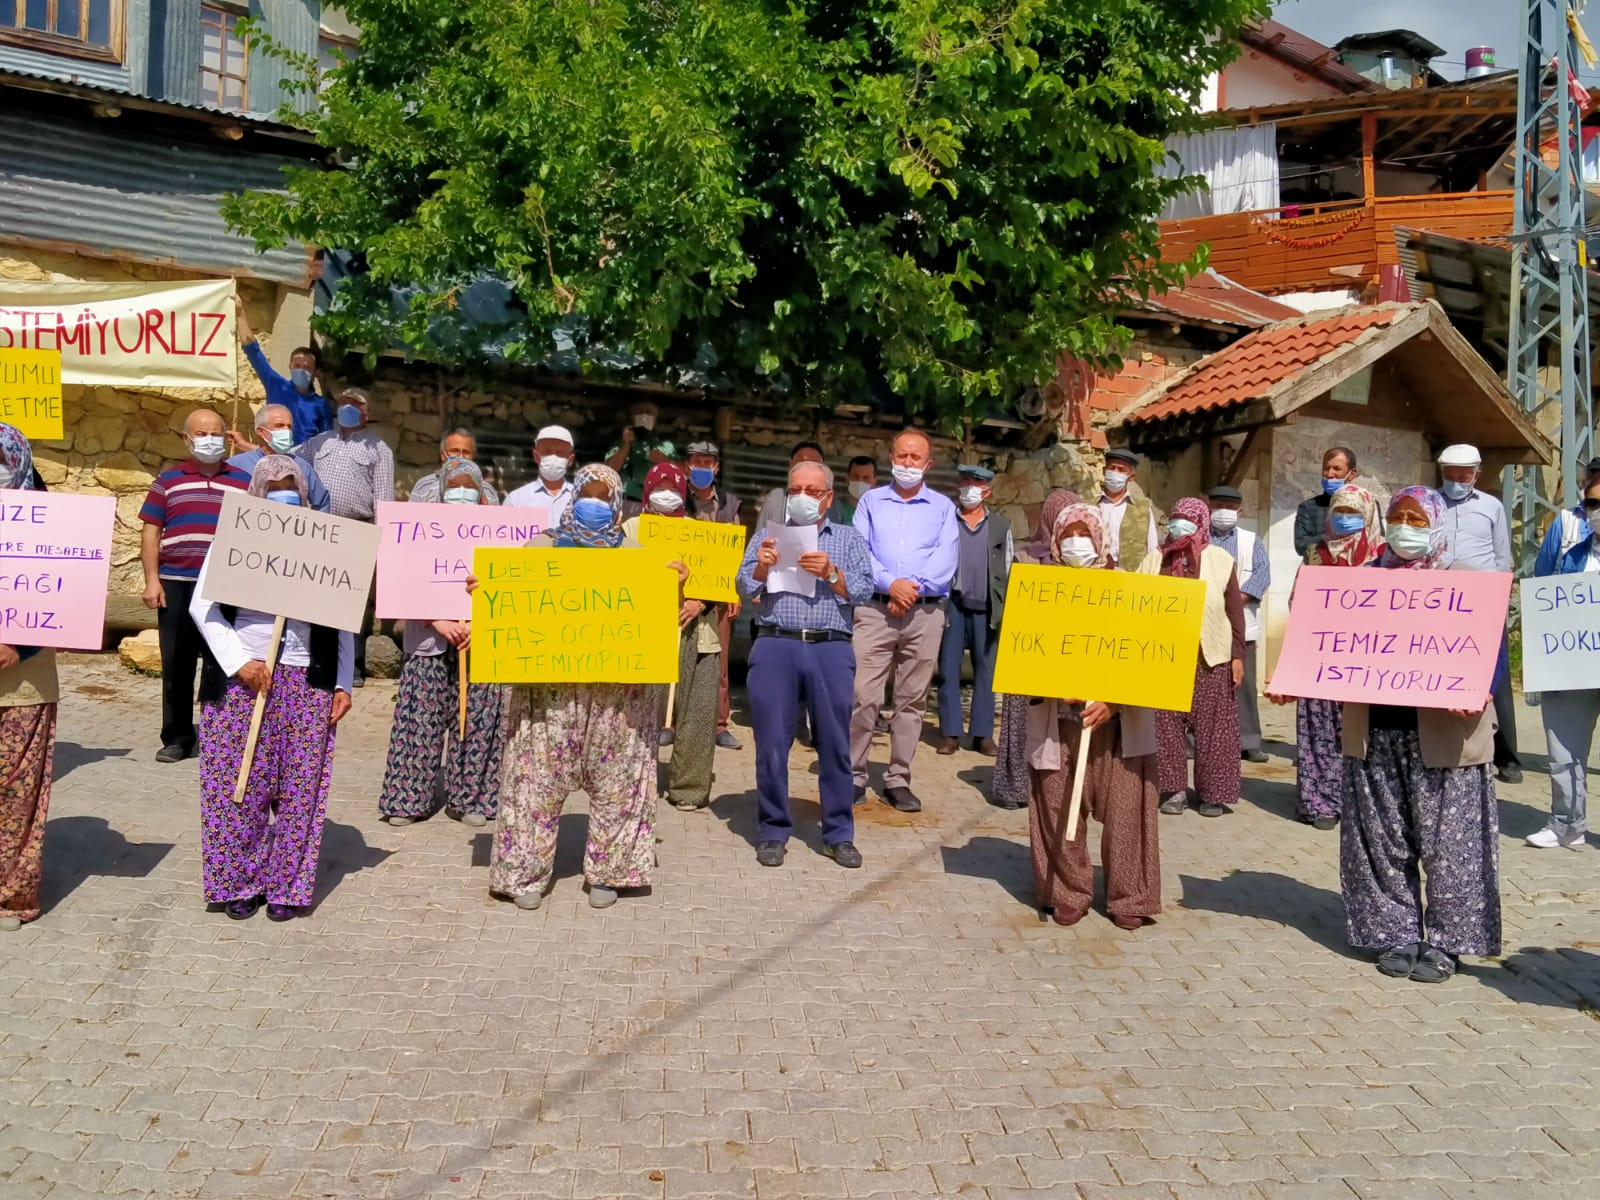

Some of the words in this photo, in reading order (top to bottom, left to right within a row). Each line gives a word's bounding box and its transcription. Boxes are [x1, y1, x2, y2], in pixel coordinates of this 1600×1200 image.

[234, 506, 341, 544] KÖYÜME
[35, 544, 103, 558] MESAFEYE
[1017, 580, 1188, 614] MERALARIMIZI
[1315, 588, 1378, 610] TOZ
[1389, 587, 1474, 613] DEĞİL
[1010, 631, 1046, 656] YOK
[1312, 630, 1397, 655] TEMİZ
[1408, 633, 1481, 656] HAVA
